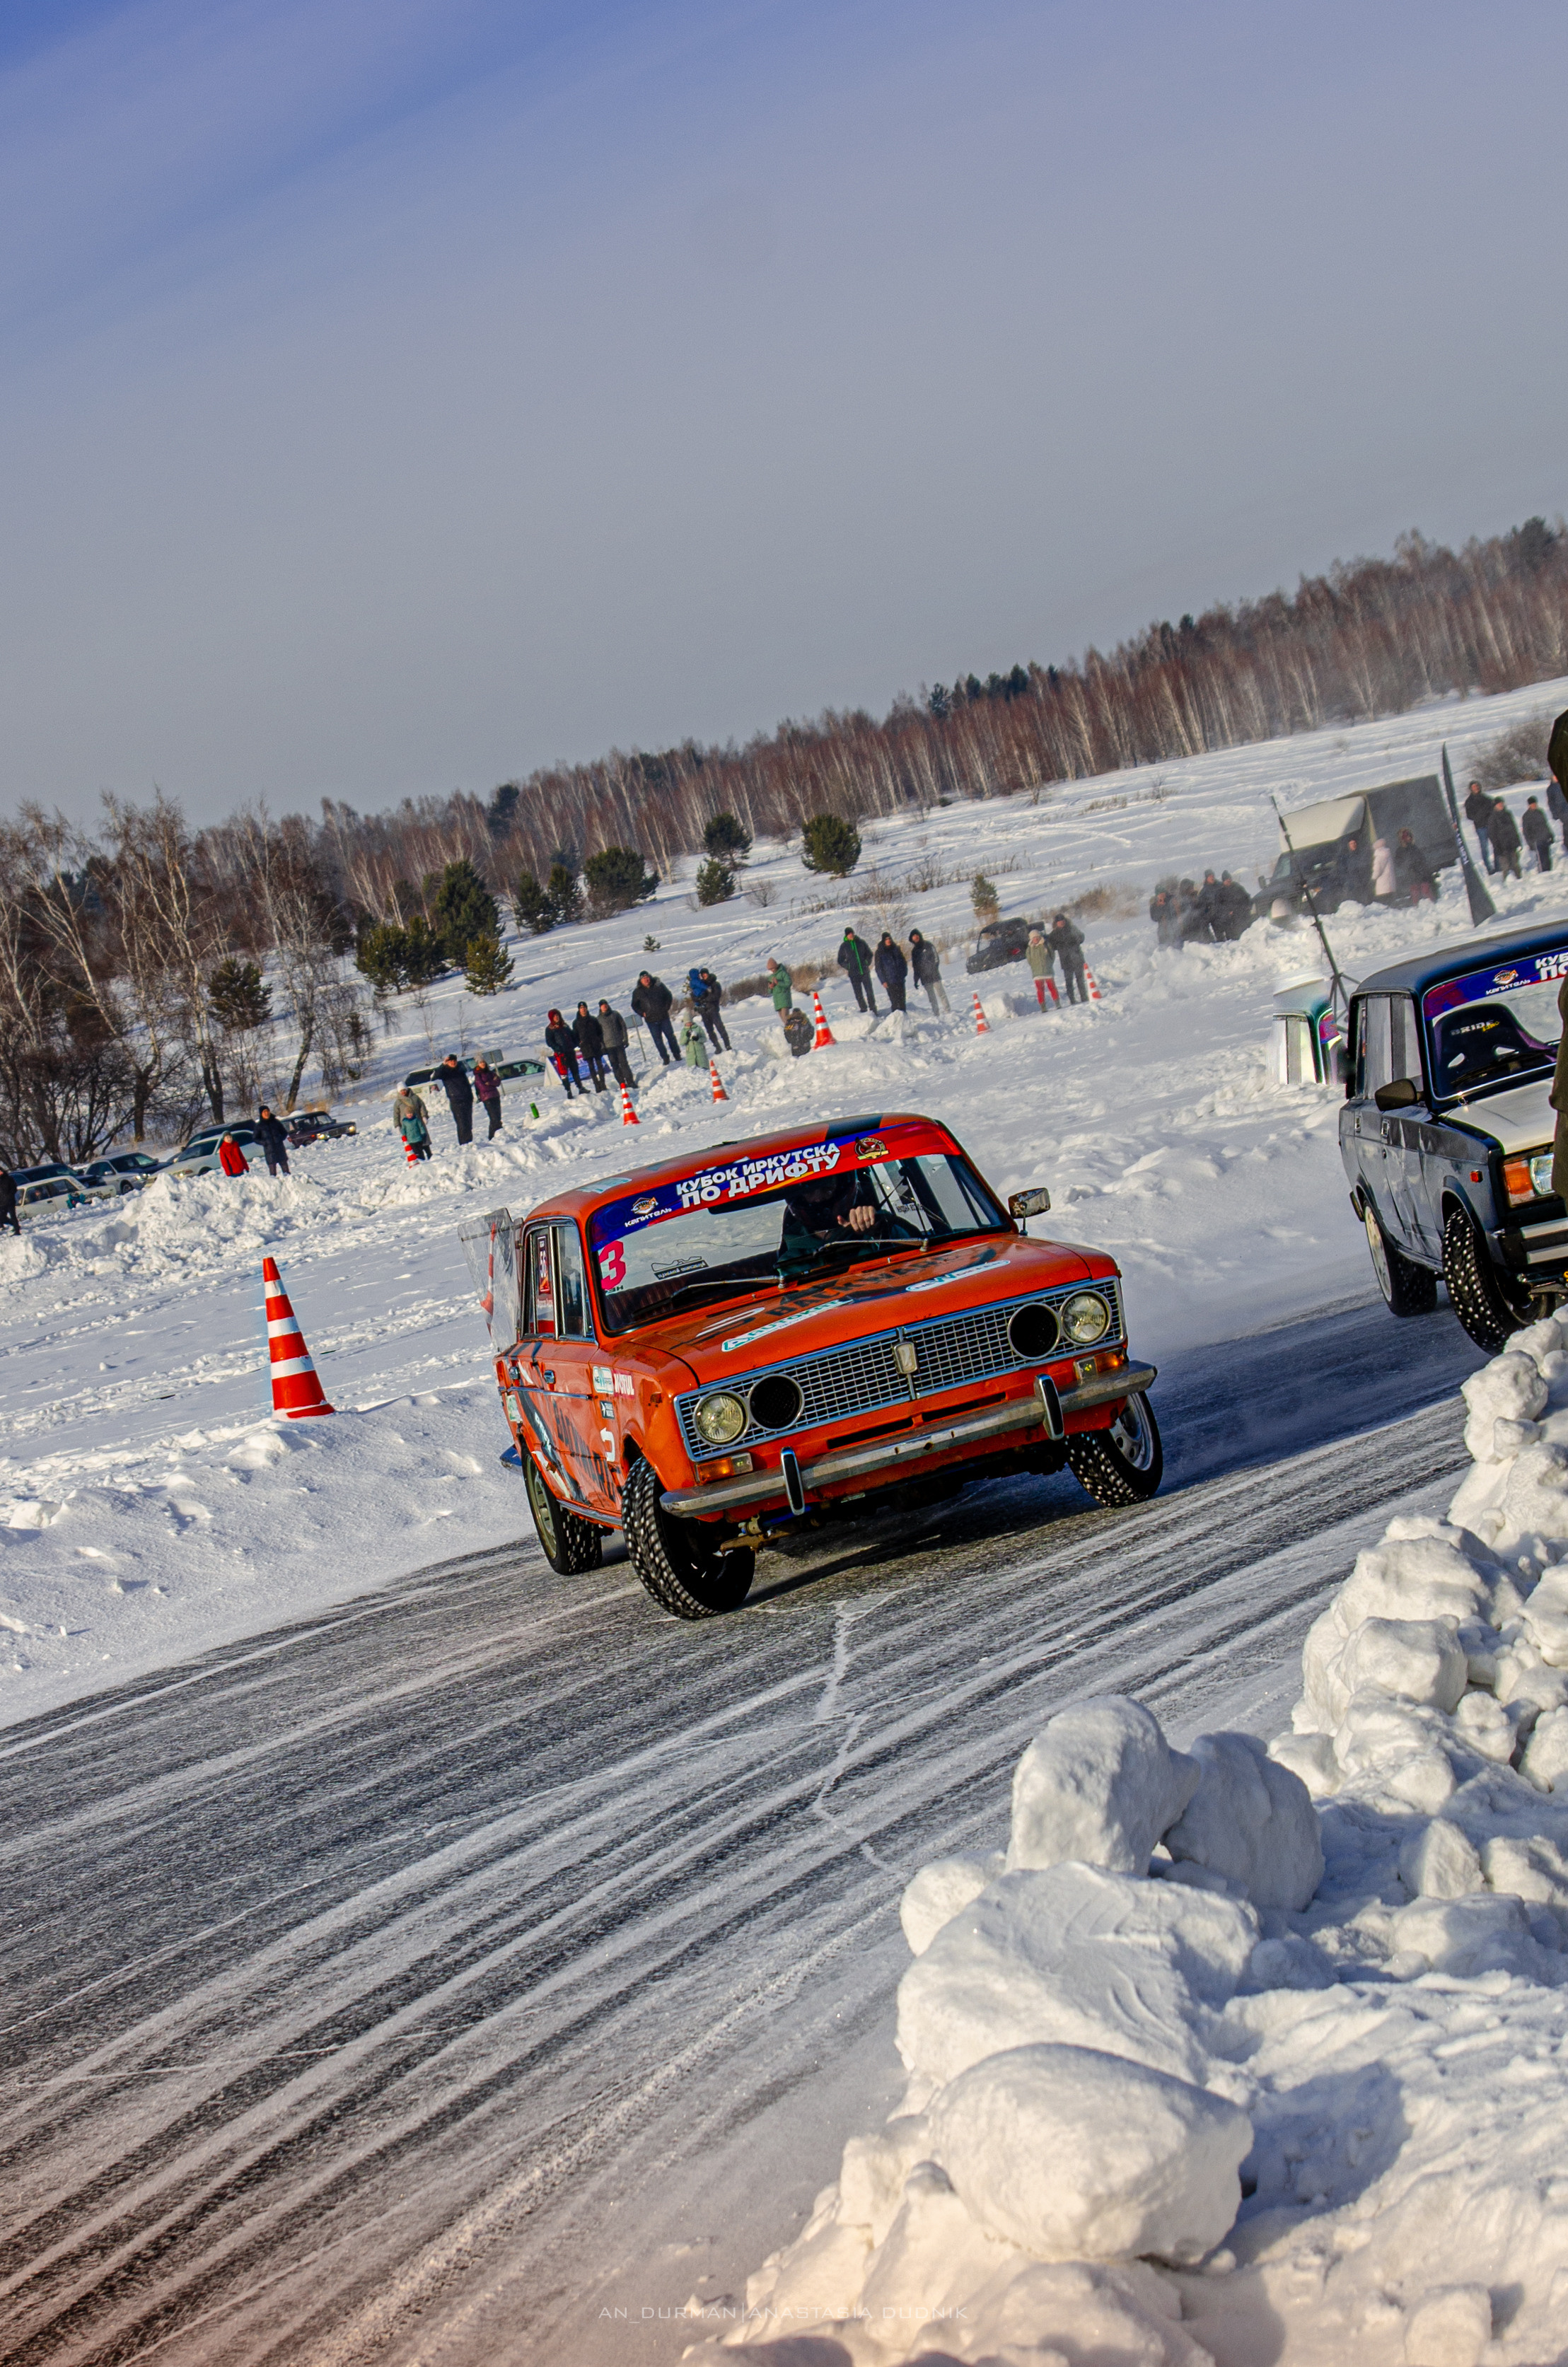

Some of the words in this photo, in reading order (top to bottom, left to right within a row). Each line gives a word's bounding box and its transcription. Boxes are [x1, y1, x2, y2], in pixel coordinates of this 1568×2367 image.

[676, 1168, 738, 1195] КУБОК
[743, 1143, 840, 1175] ИРКУТСКА
[681, 1186, 721, 1209] ПО
[728, 1152, 840, 1198] ДРИФТУ
[598, 1240, 627, 1291] 3
[614, 1373, 634, 1395] MOTUL
